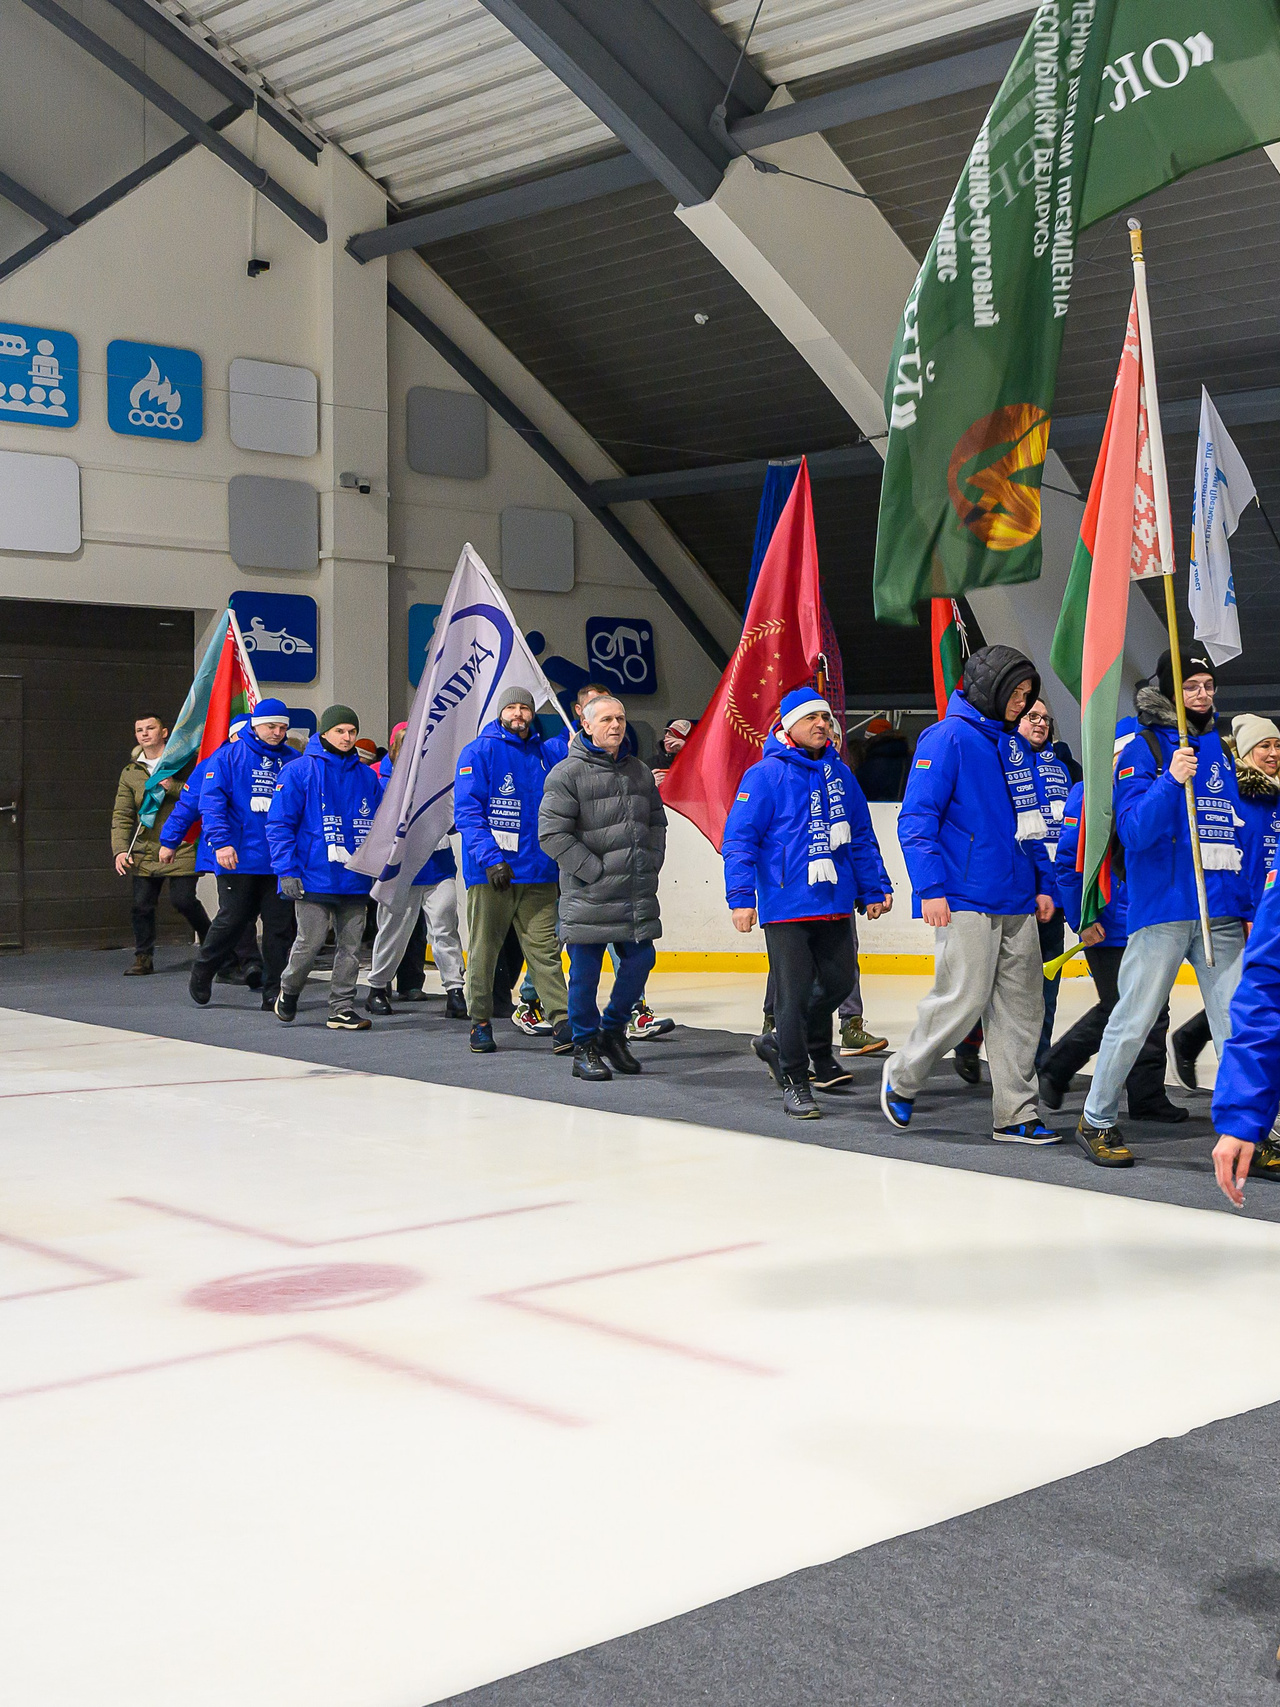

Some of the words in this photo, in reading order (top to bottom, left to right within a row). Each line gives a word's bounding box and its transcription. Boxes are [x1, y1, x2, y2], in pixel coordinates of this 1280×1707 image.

[1033, 1, 1062, 143] ЕСПУБЛИКИ
[1033, 146, 1056, 259] БЕЛАРУСЬ
[490, 809, 520, 818] АКАДЕМИЯ
